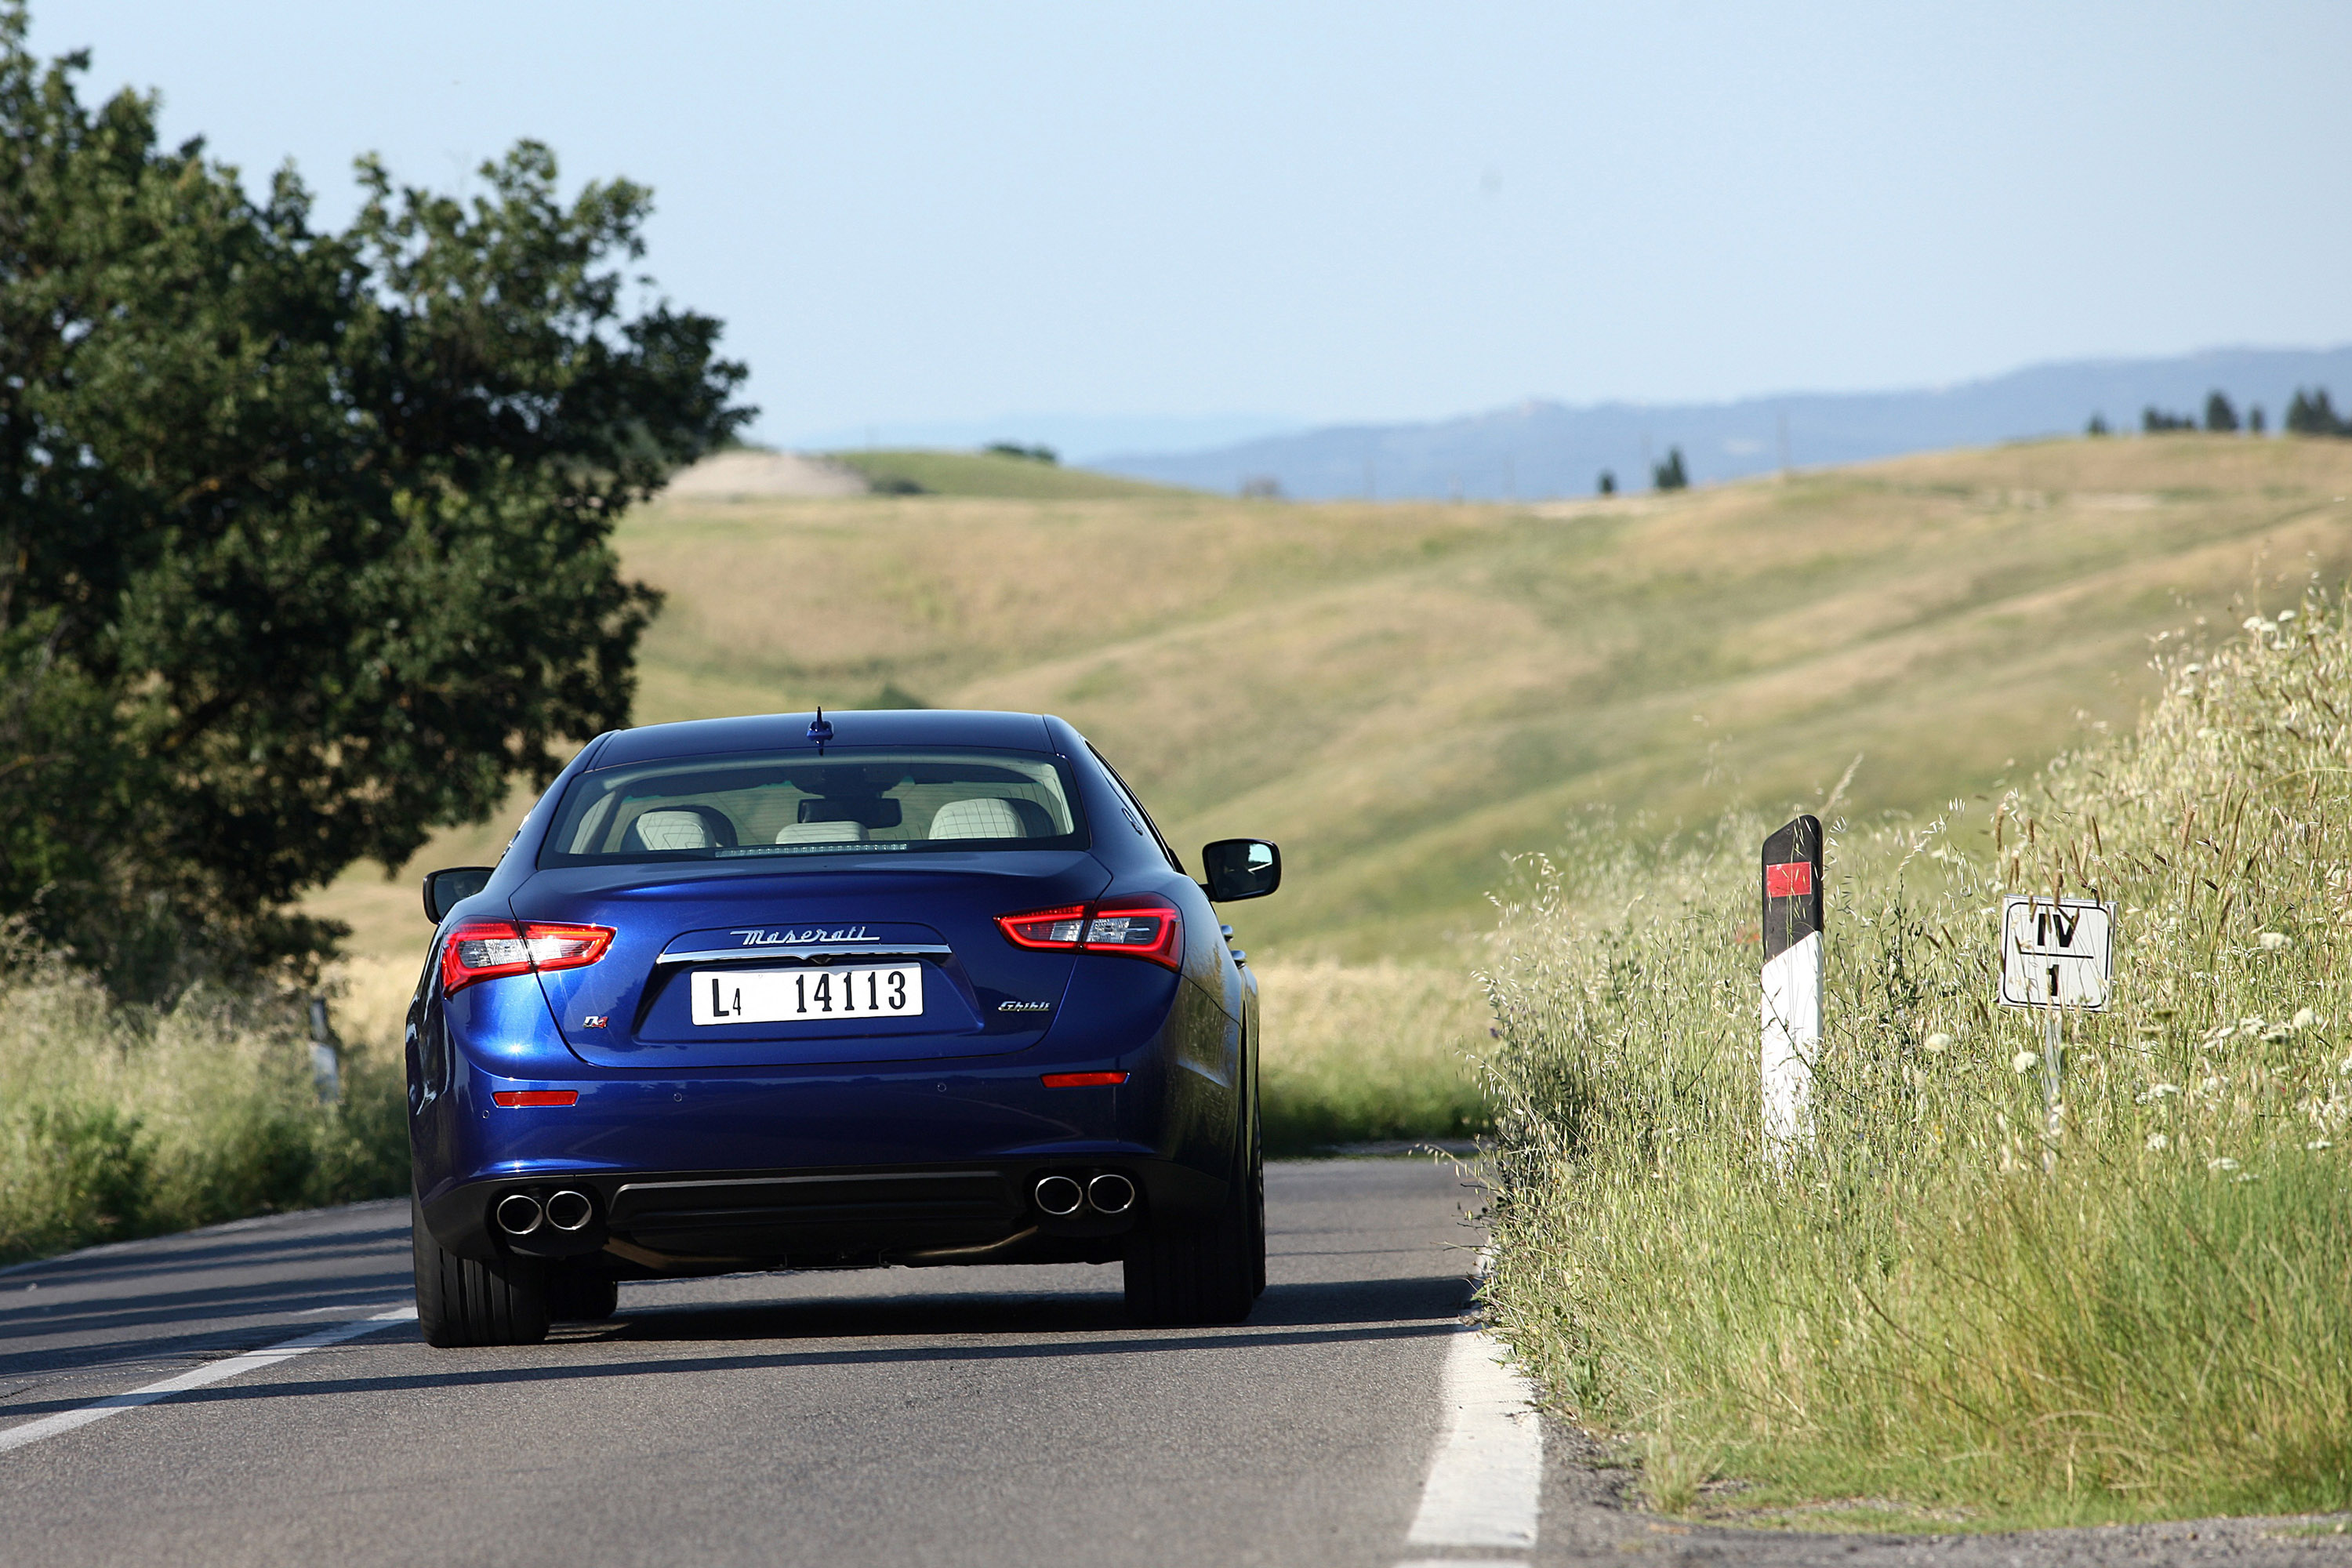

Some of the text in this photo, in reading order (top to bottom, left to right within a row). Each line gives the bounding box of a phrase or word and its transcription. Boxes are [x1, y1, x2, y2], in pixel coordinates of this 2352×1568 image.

[730, 926, 880, 946] Maserati
[2038, 913, 2078, 948] IV
[796, 971, 906, 1013] 14113
[2047, 964, 2060, 996] 1
